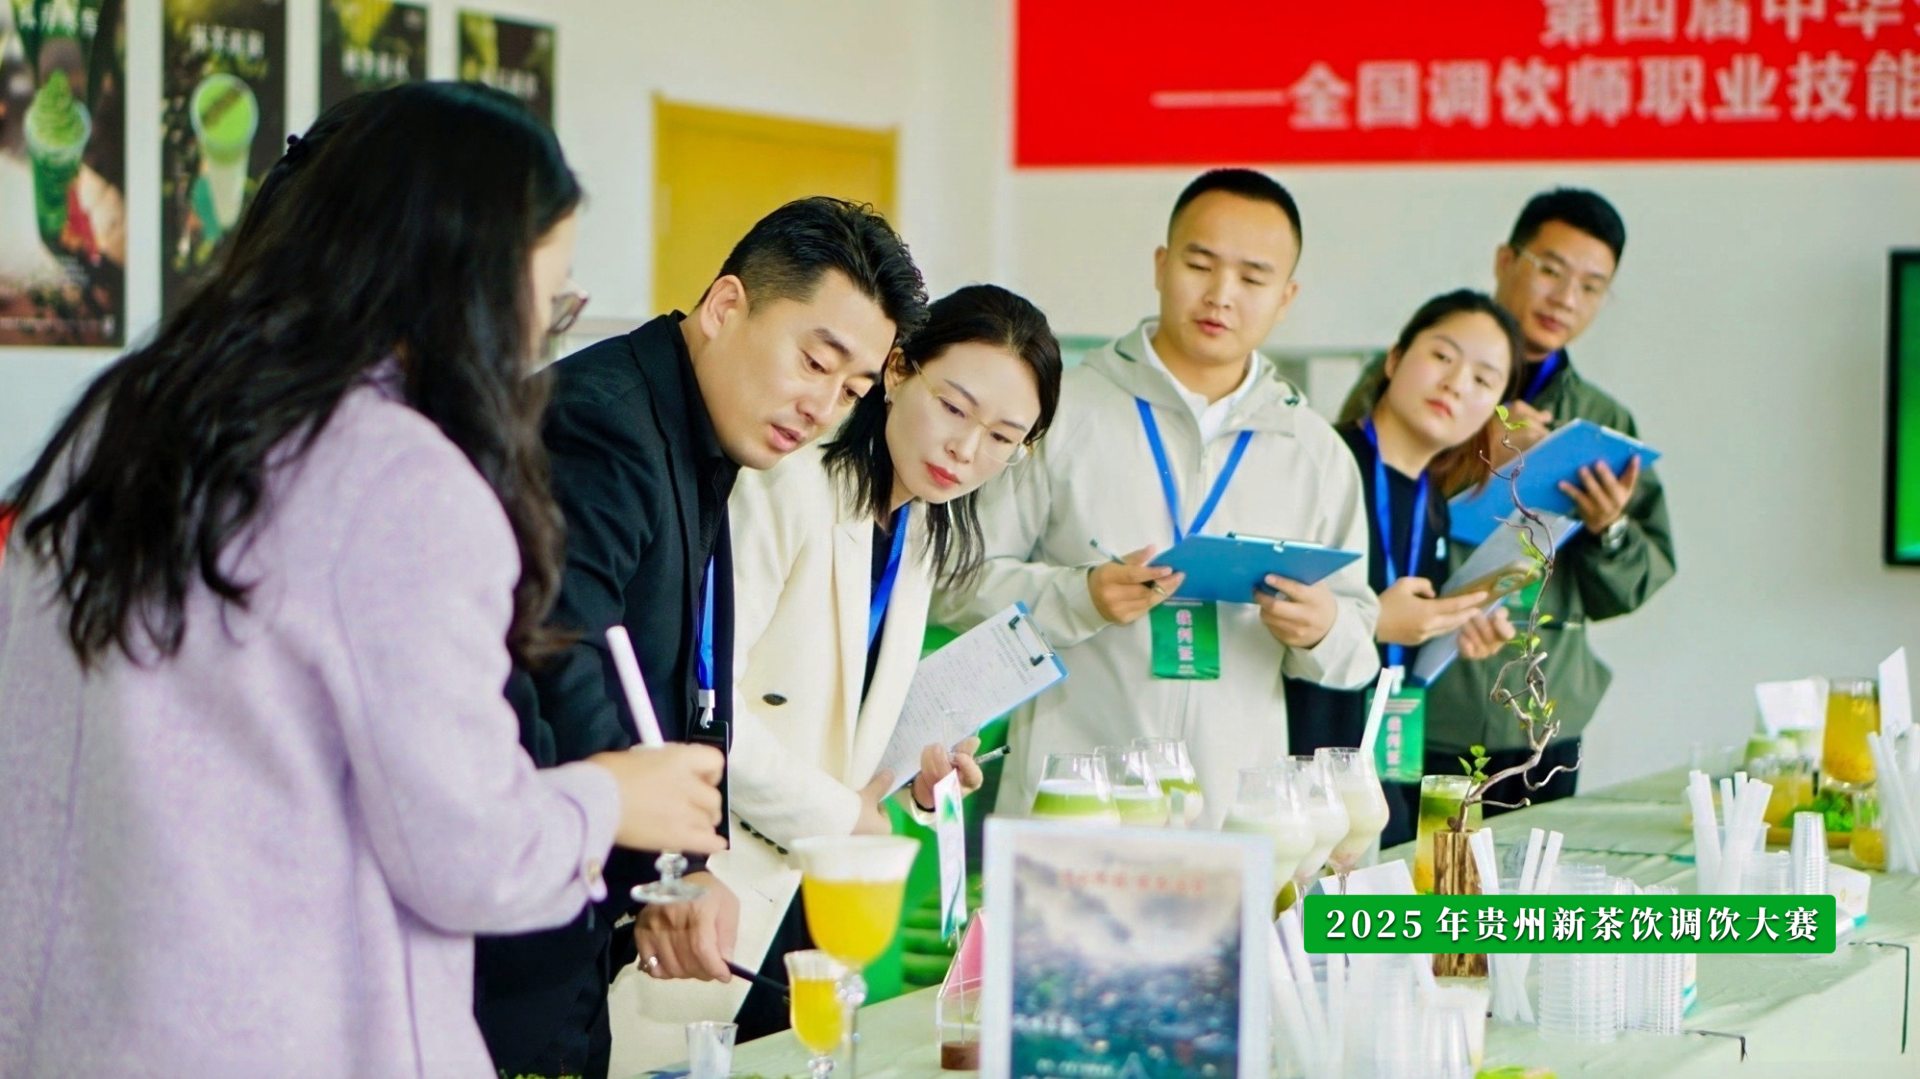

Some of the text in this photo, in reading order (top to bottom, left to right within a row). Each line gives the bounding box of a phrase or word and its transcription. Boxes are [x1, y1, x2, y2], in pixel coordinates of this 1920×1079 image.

[1538, 0, 1920, 49] 第四届中华
